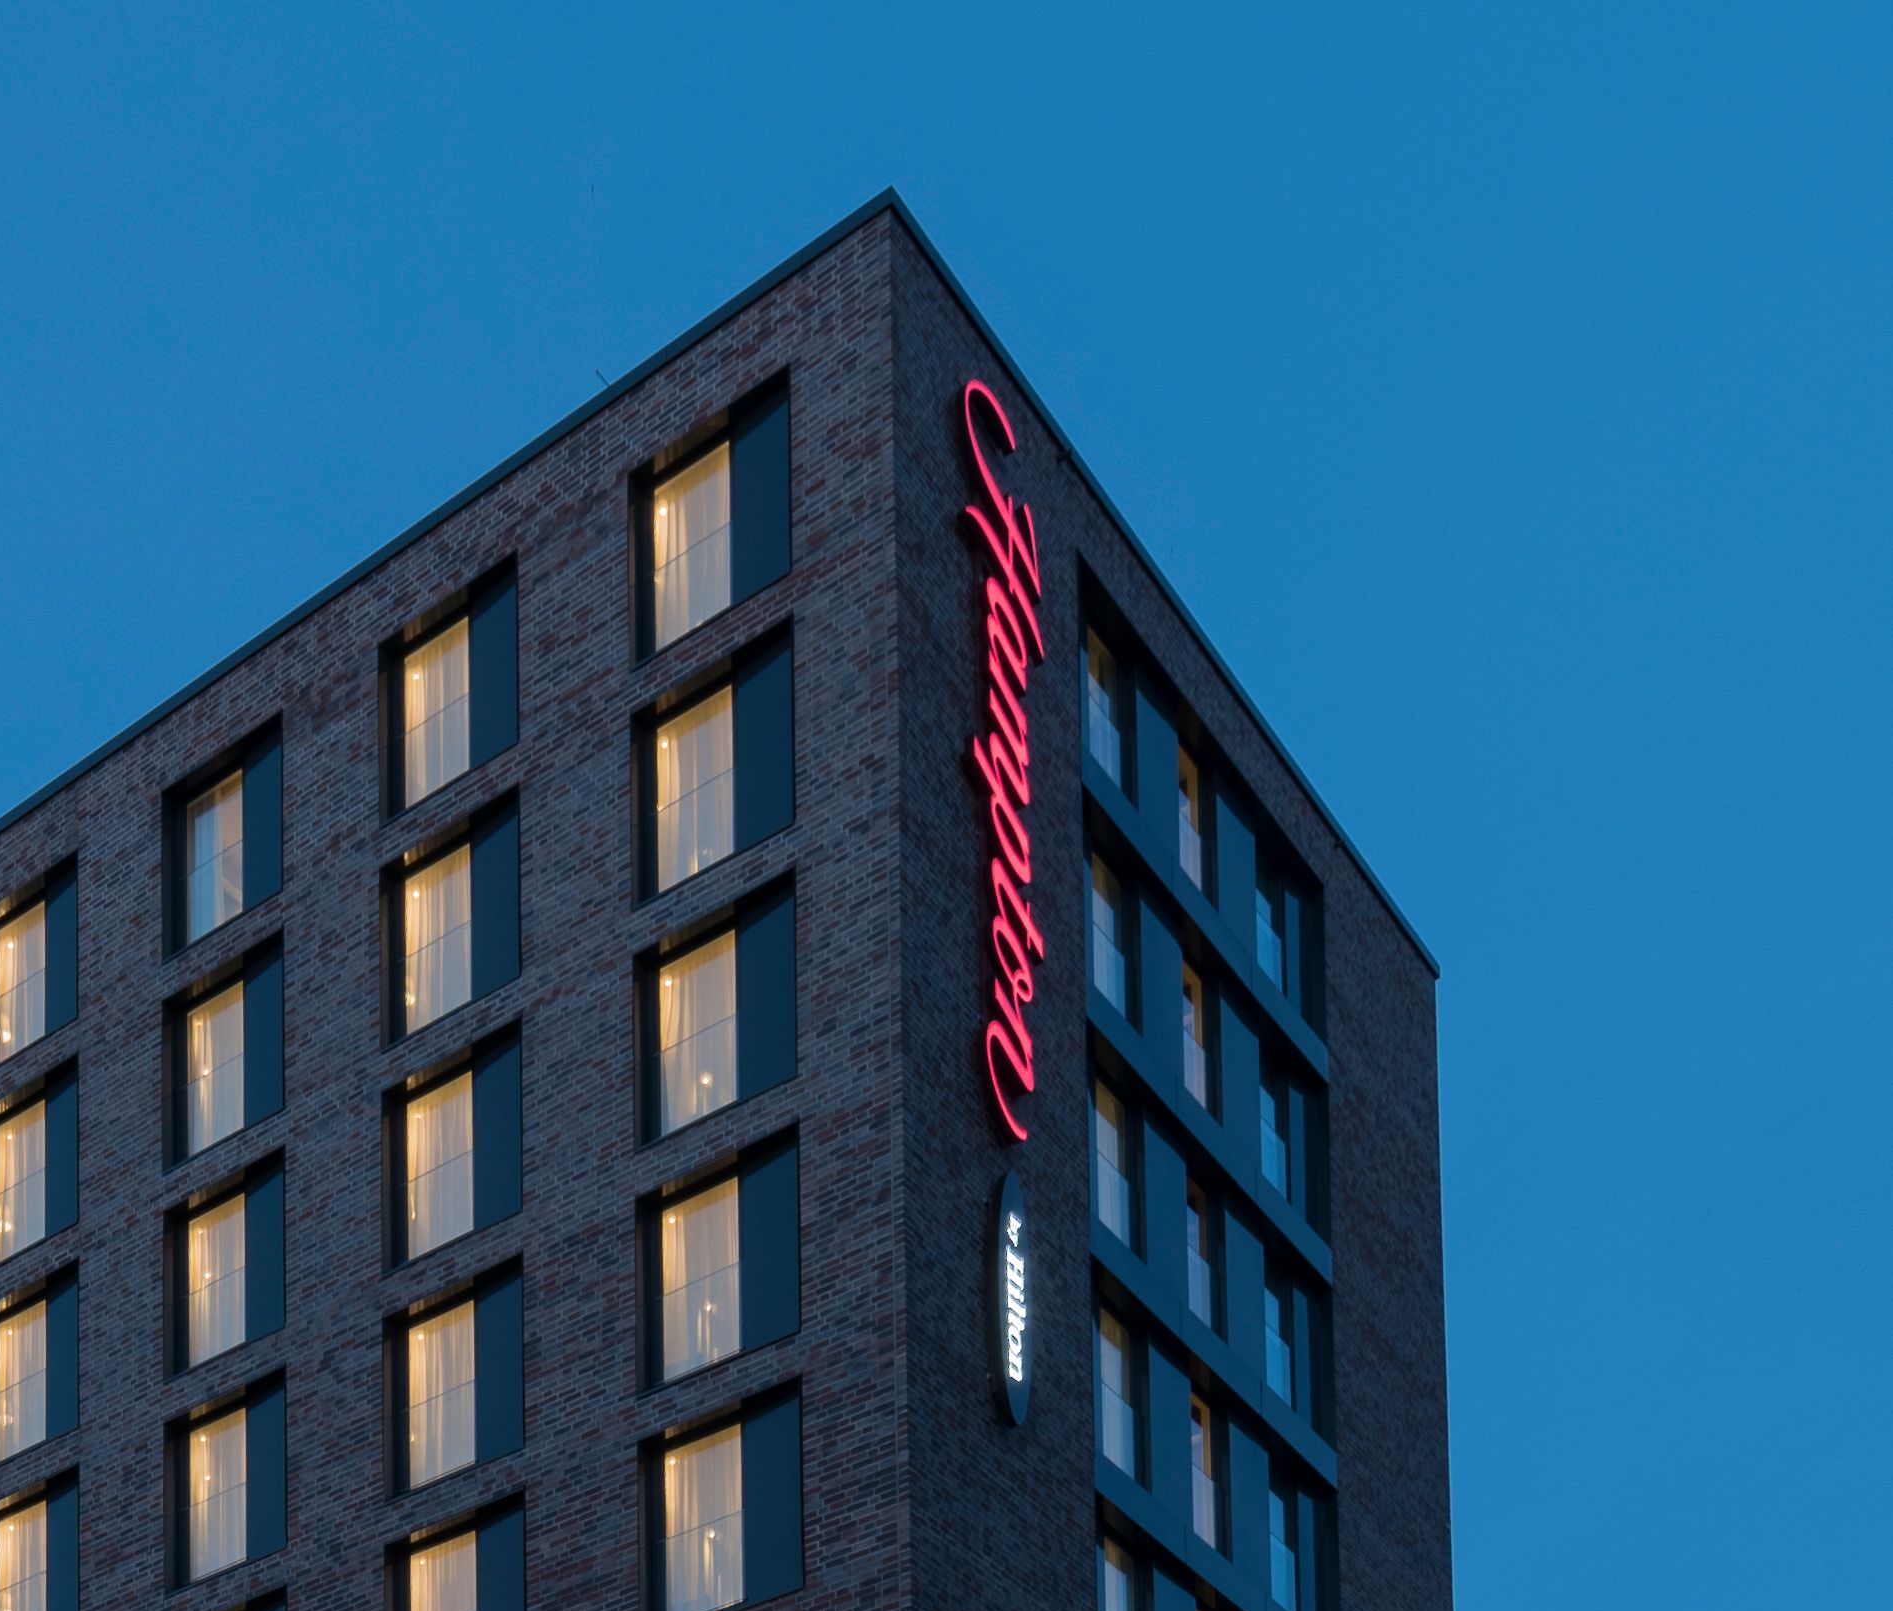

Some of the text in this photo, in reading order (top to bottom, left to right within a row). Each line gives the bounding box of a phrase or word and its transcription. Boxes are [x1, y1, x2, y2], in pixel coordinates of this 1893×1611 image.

[964, 379, 1045, 1141] Hampton
[1006, 1211, 1027, 1382] by Hilton
